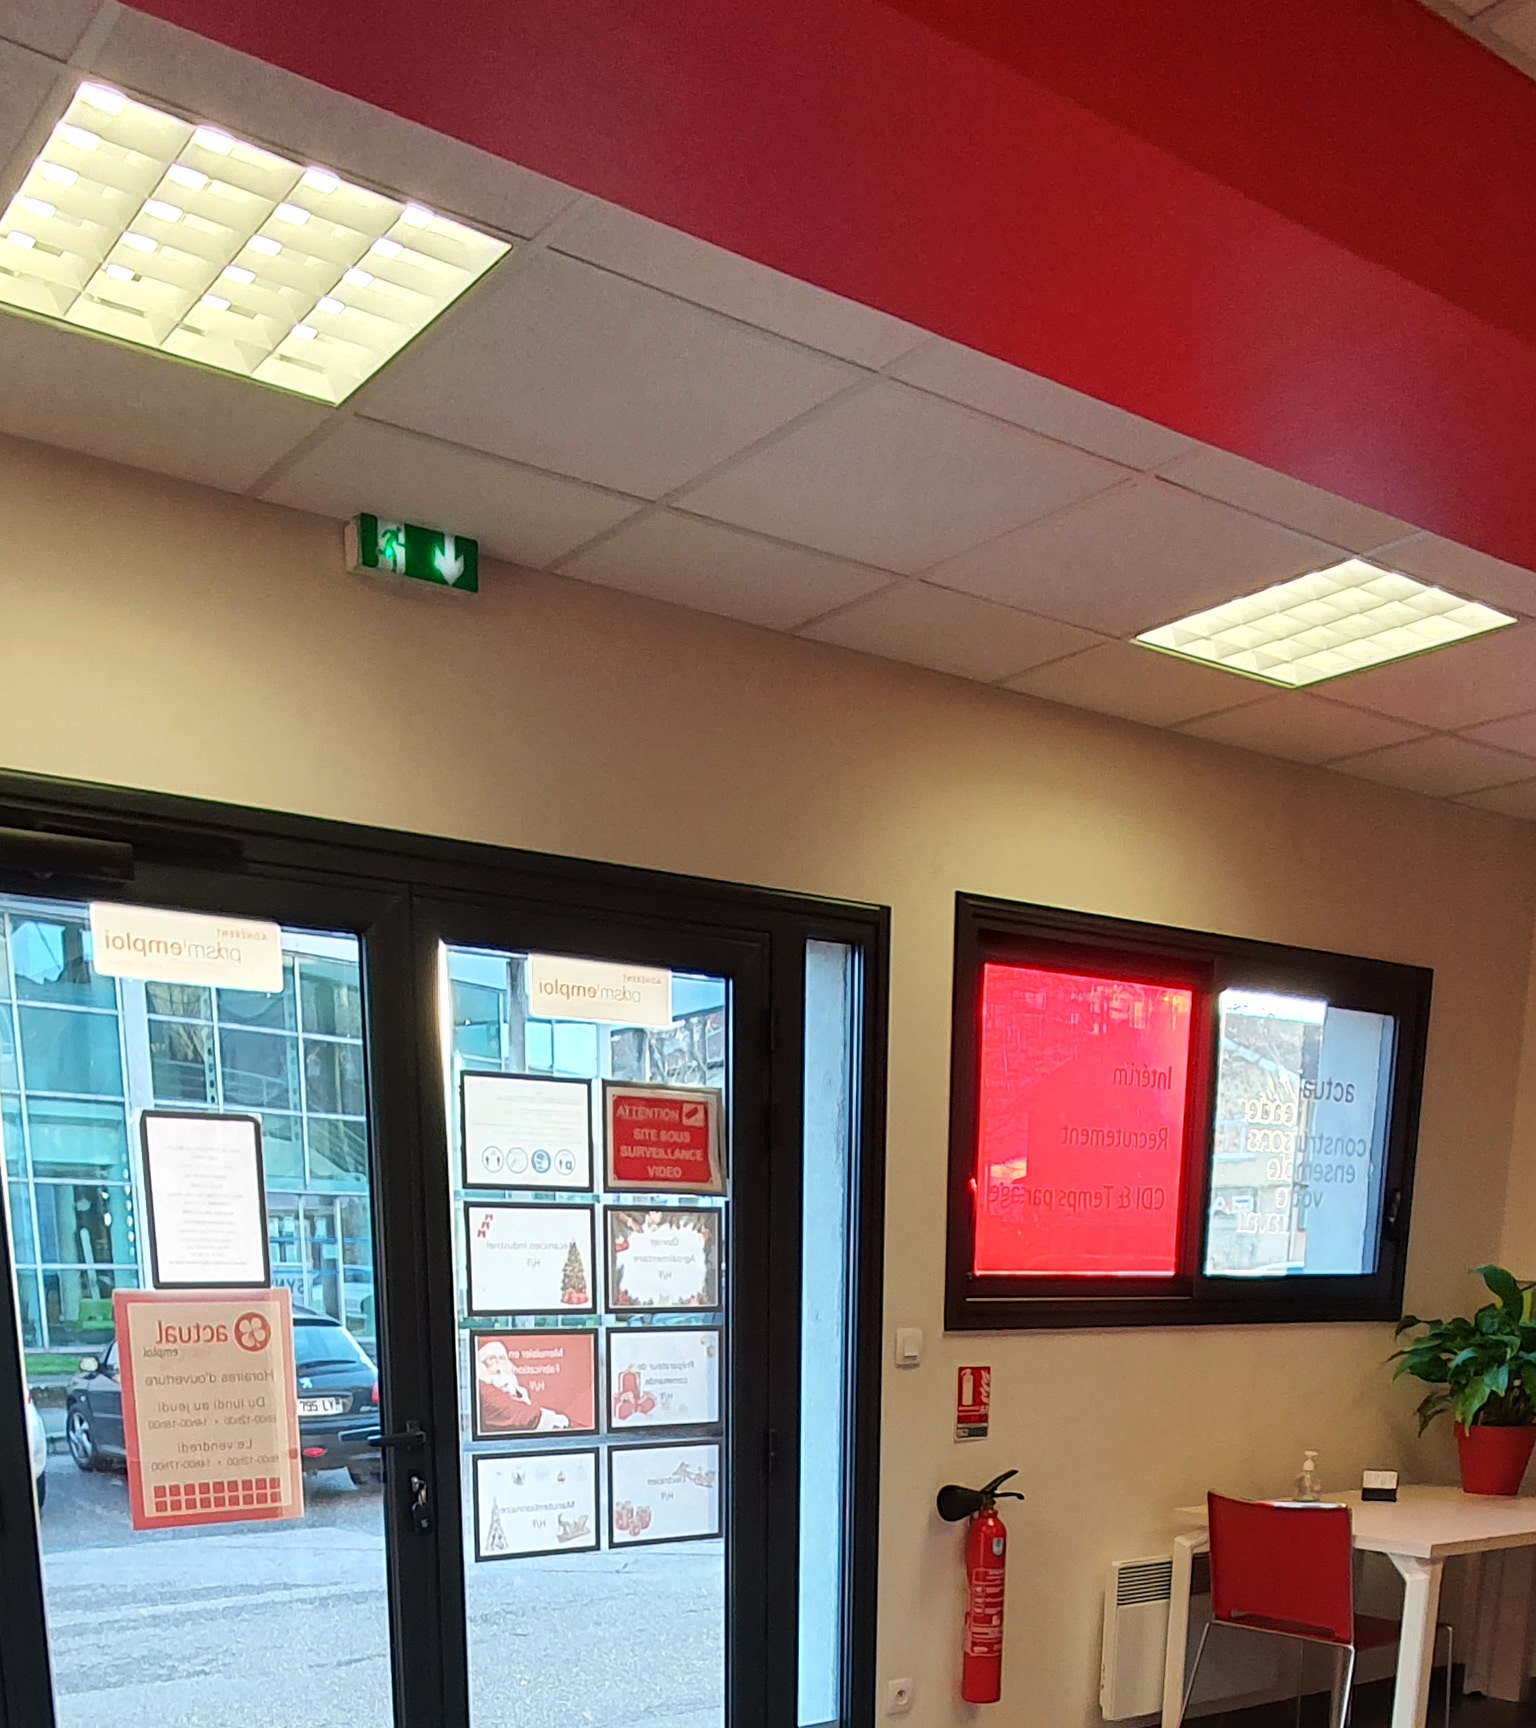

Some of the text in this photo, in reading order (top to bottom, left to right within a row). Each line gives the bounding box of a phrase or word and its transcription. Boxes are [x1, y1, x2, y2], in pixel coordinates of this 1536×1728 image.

[615, 1105, 680, 1122] ATTENTION
[633, 1128, 690, 1143] SITE SOUS
[619, 1145, 704, 1162] SURVEILLANCE
